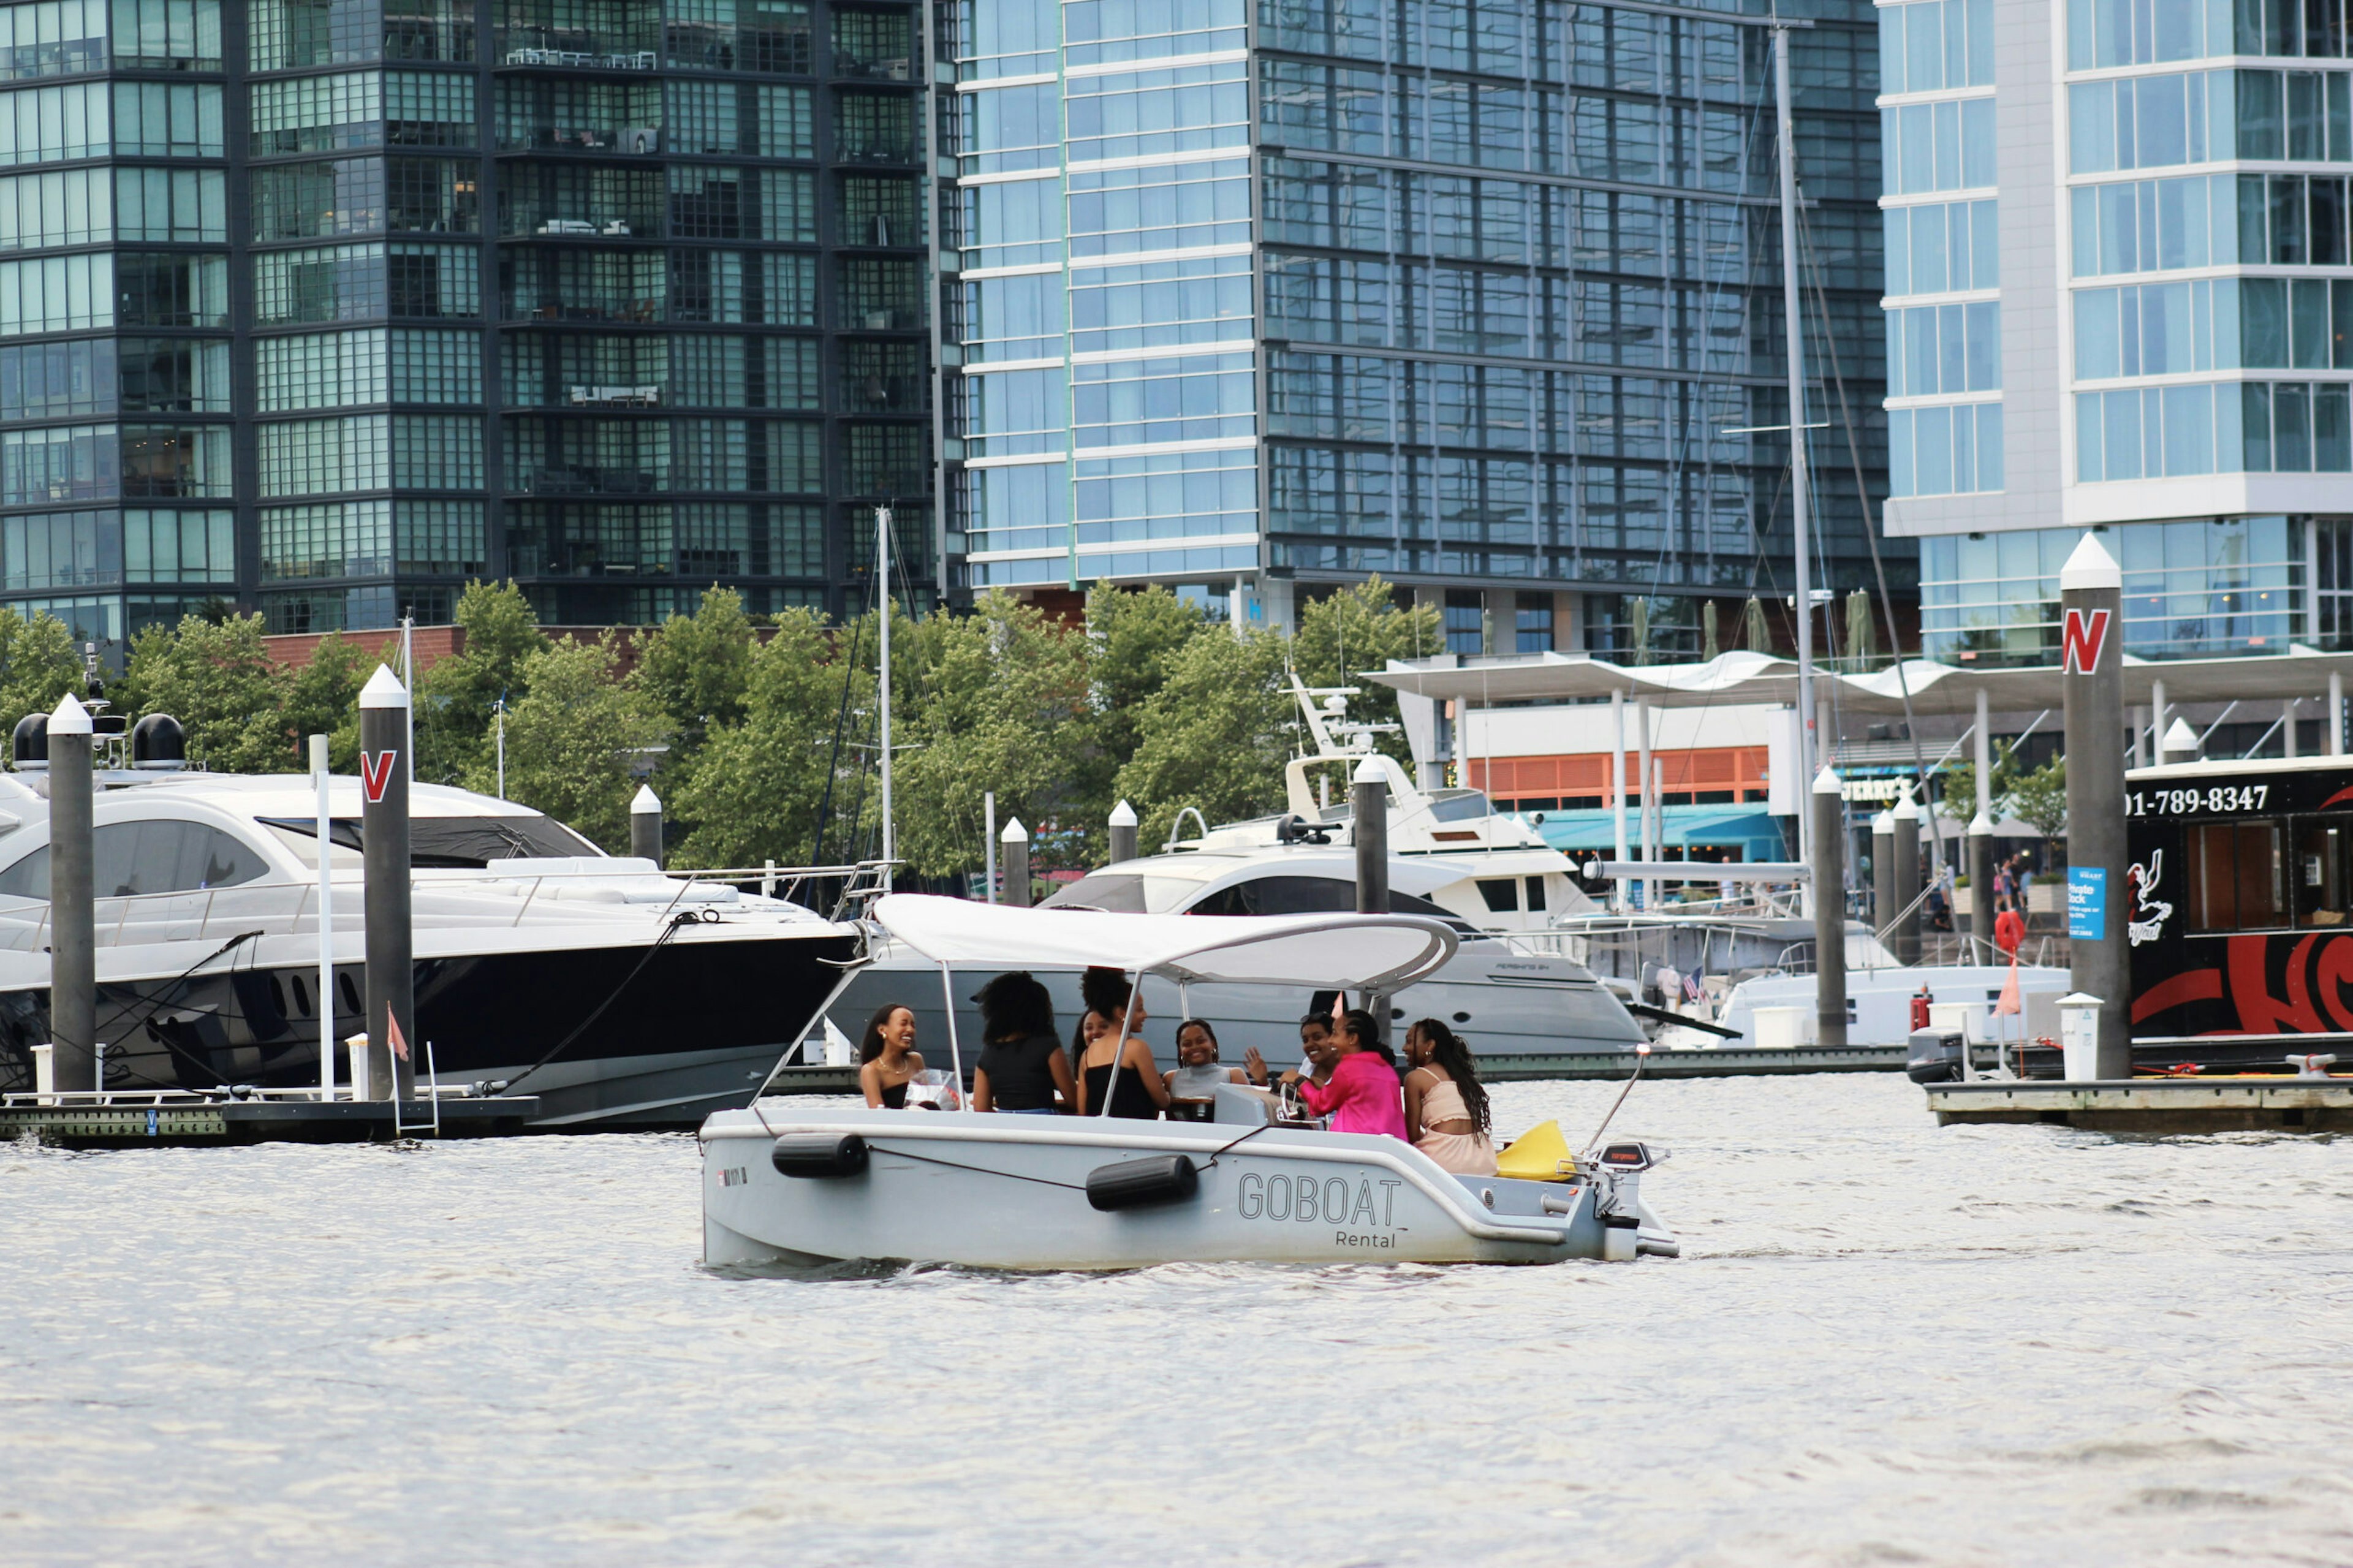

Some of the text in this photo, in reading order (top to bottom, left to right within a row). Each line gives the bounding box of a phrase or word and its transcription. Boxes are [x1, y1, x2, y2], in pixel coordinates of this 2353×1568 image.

[362, 750, 397, 803] V
[1841, 776, 1912, 801] JERRY'S
[1238, 1173, 1401, 1226] GOBOAT
[1336, 1231, 1395, 1248] Rental
